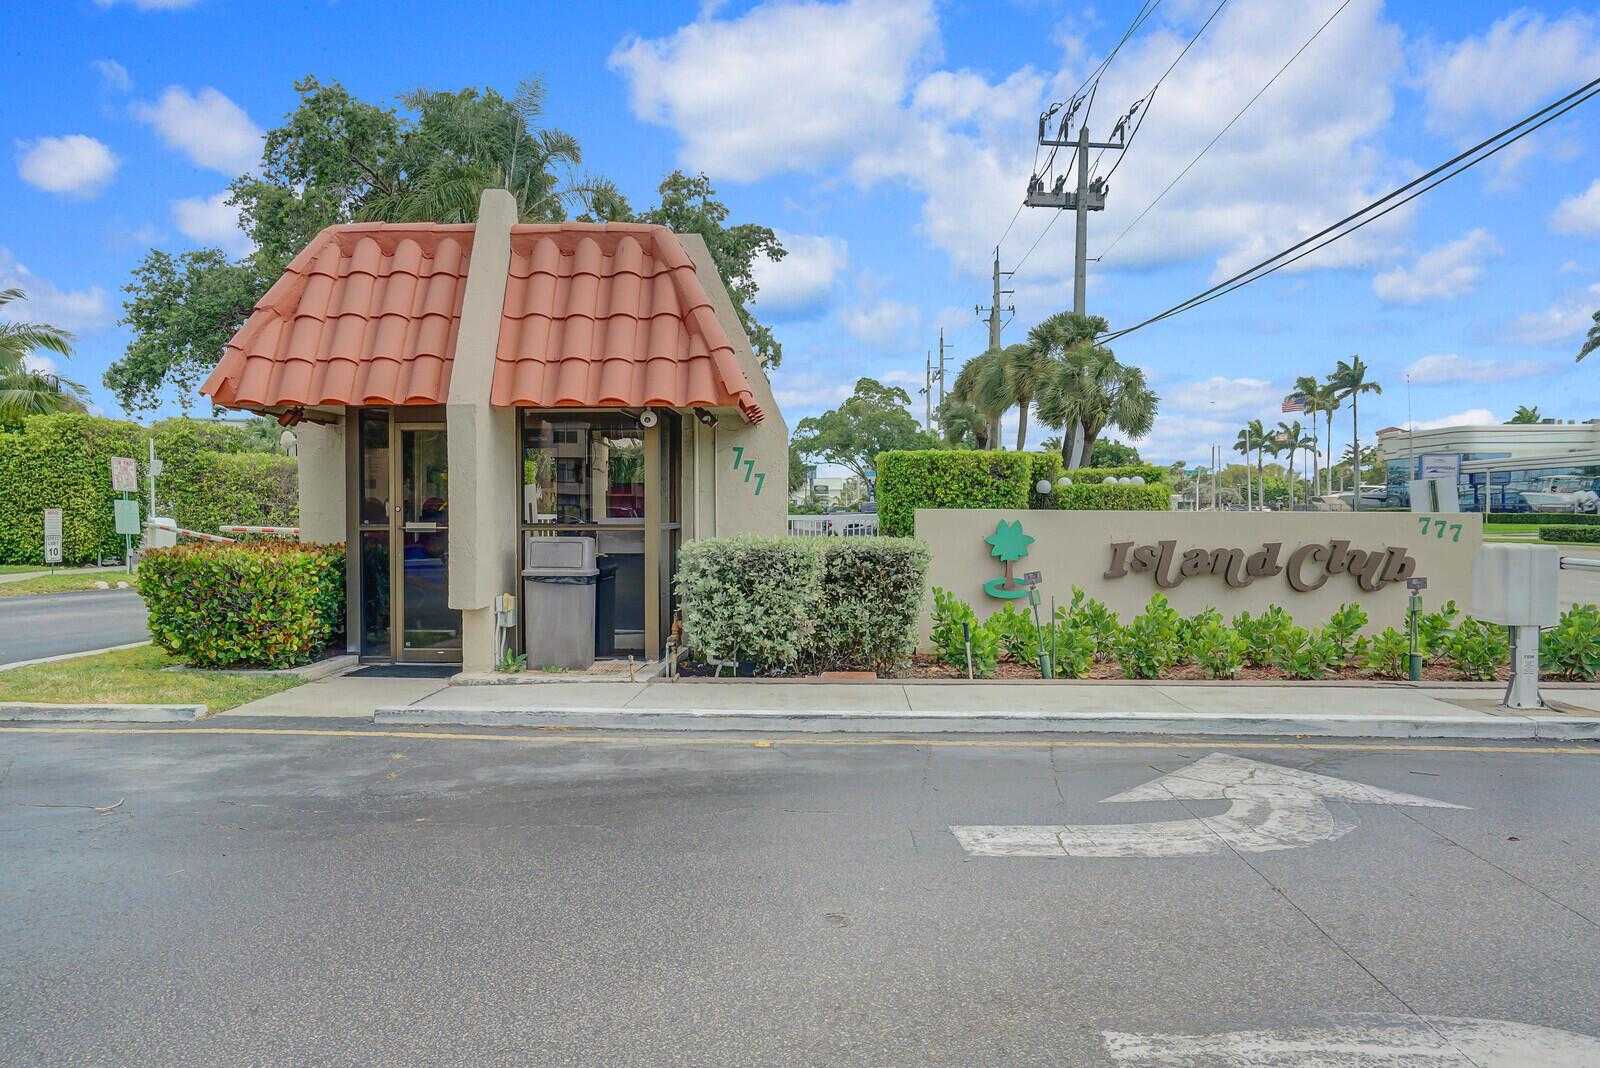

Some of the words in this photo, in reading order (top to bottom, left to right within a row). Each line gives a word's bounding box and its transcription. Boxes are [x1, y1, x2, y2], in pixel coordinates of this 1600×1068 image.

[732, 446, 766, 496] 777
[1419, 517, 1462, 542] 777
[49, 547, 59, 556] 10
[1103, 539, 1283, 588] Island
[1286, 539, 1416, 593] Club
